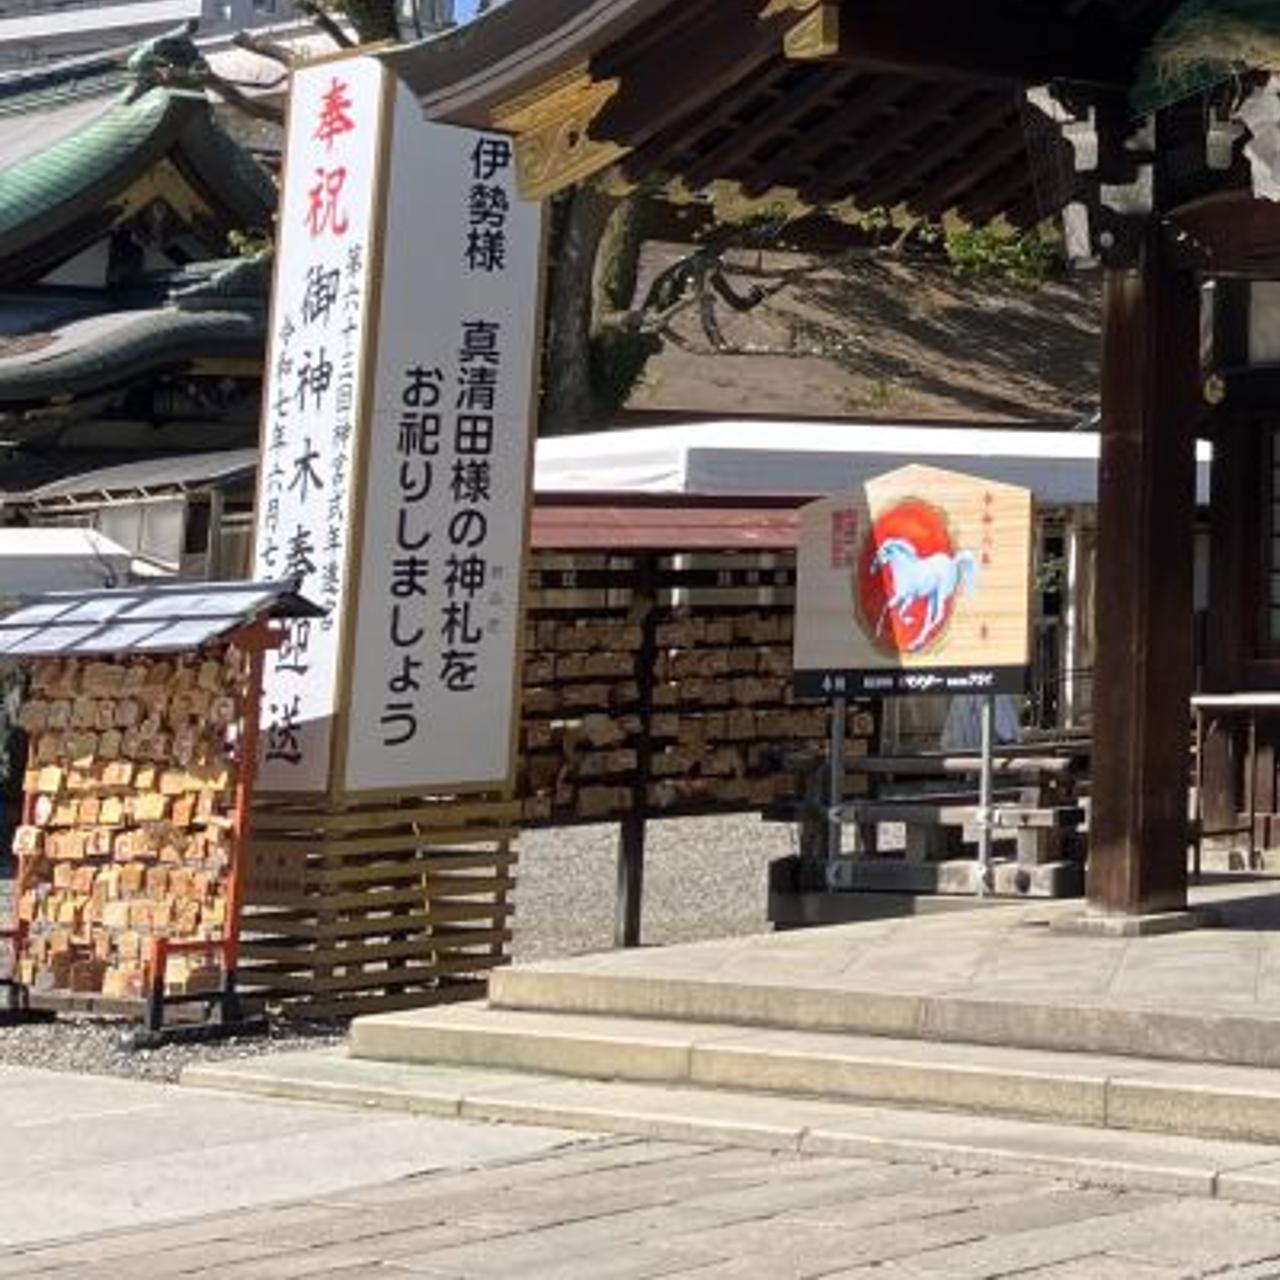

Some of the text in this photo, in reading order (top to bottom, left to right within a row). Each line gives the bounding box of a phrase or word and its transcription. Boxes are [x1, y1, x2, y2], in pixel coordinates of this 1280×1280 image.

[303, 76, 356, 242] 奉祝
[259, 316, 295, 582] 令和七年六月七
[380, 365, 444, 746] お祀りしましょう
[438, 136, 512, 692] 伊勢様 真清田様の神札を
